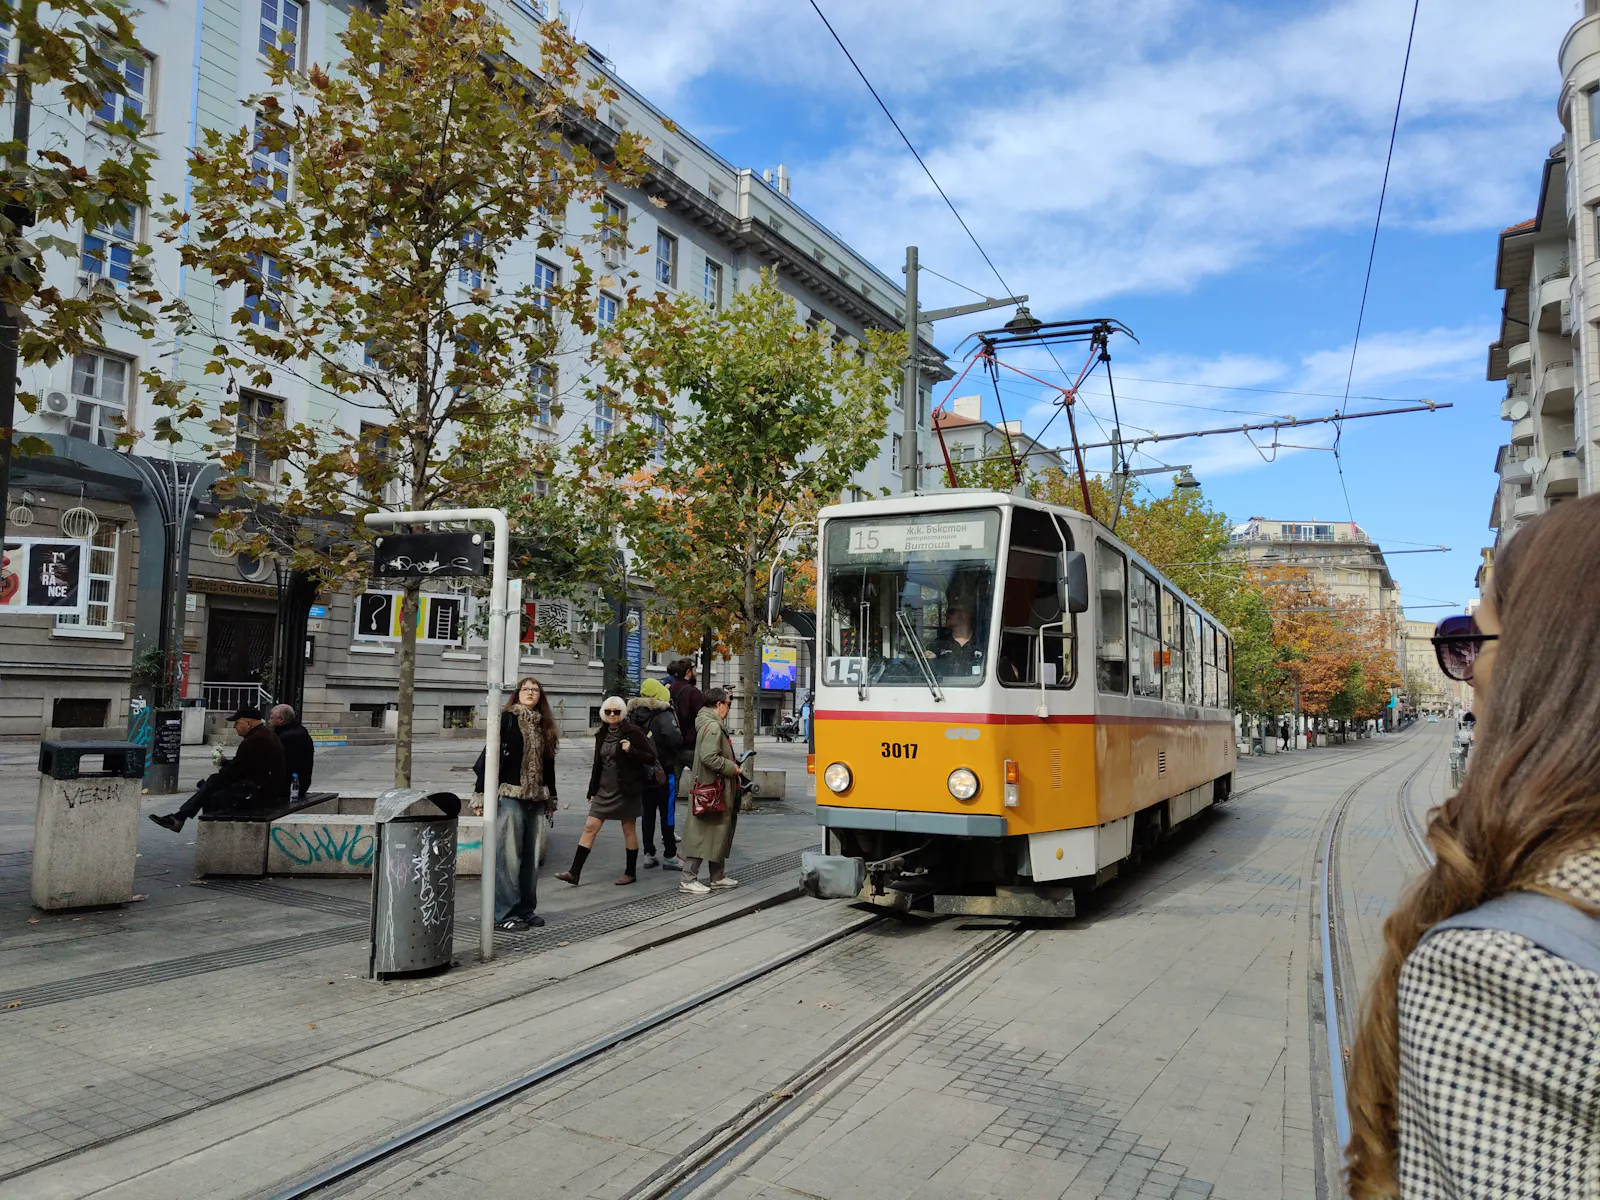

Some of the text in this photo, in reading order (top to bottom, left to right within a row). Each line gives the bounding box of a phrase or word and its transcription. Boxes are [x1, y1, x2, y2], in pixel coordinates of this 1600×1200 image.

[926, 524, 967, 534] Бъкстон
[853, 530, 880, 550] 15
[904, 541, 950, 550] Витоша
[42, 574, 56, 586] RA
[48, 586, 68, 598] NCE
[219, 584, 267, 596] СТОЛИЧНА
[829, 659, 862, 684] 15
[881, 742, 918, 759] 3017
